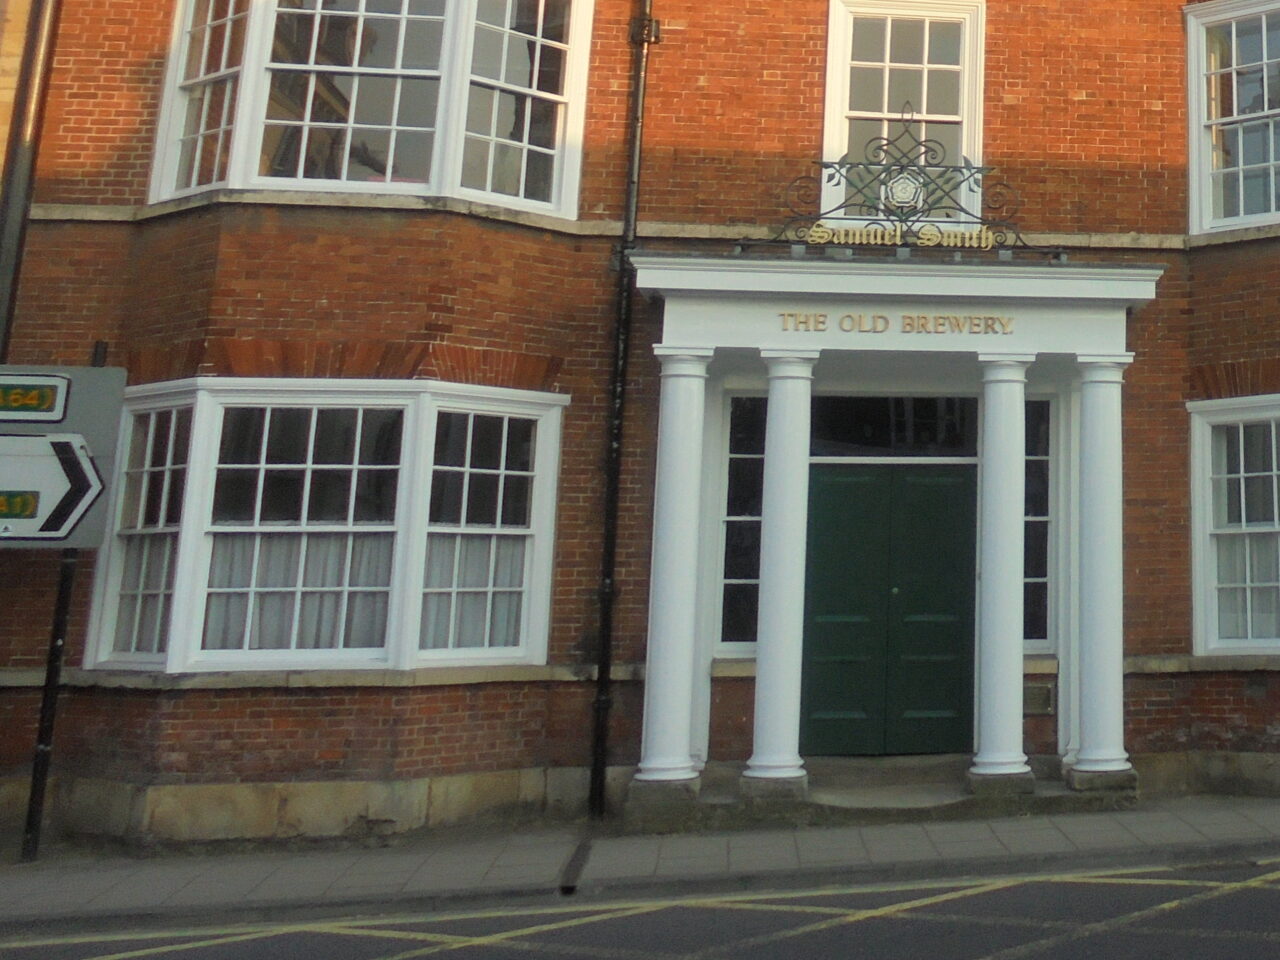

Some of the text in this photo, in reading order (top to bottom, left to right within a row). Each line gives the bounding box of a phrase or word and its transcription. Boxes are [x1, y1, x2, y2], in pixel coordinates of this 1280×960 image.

[807, 220, 994, 251] Samuel Smith
[777, 313, 828, 333] THE
[839, 314, 890, 334] OLD
[0, 388, 53, 409] 64)
